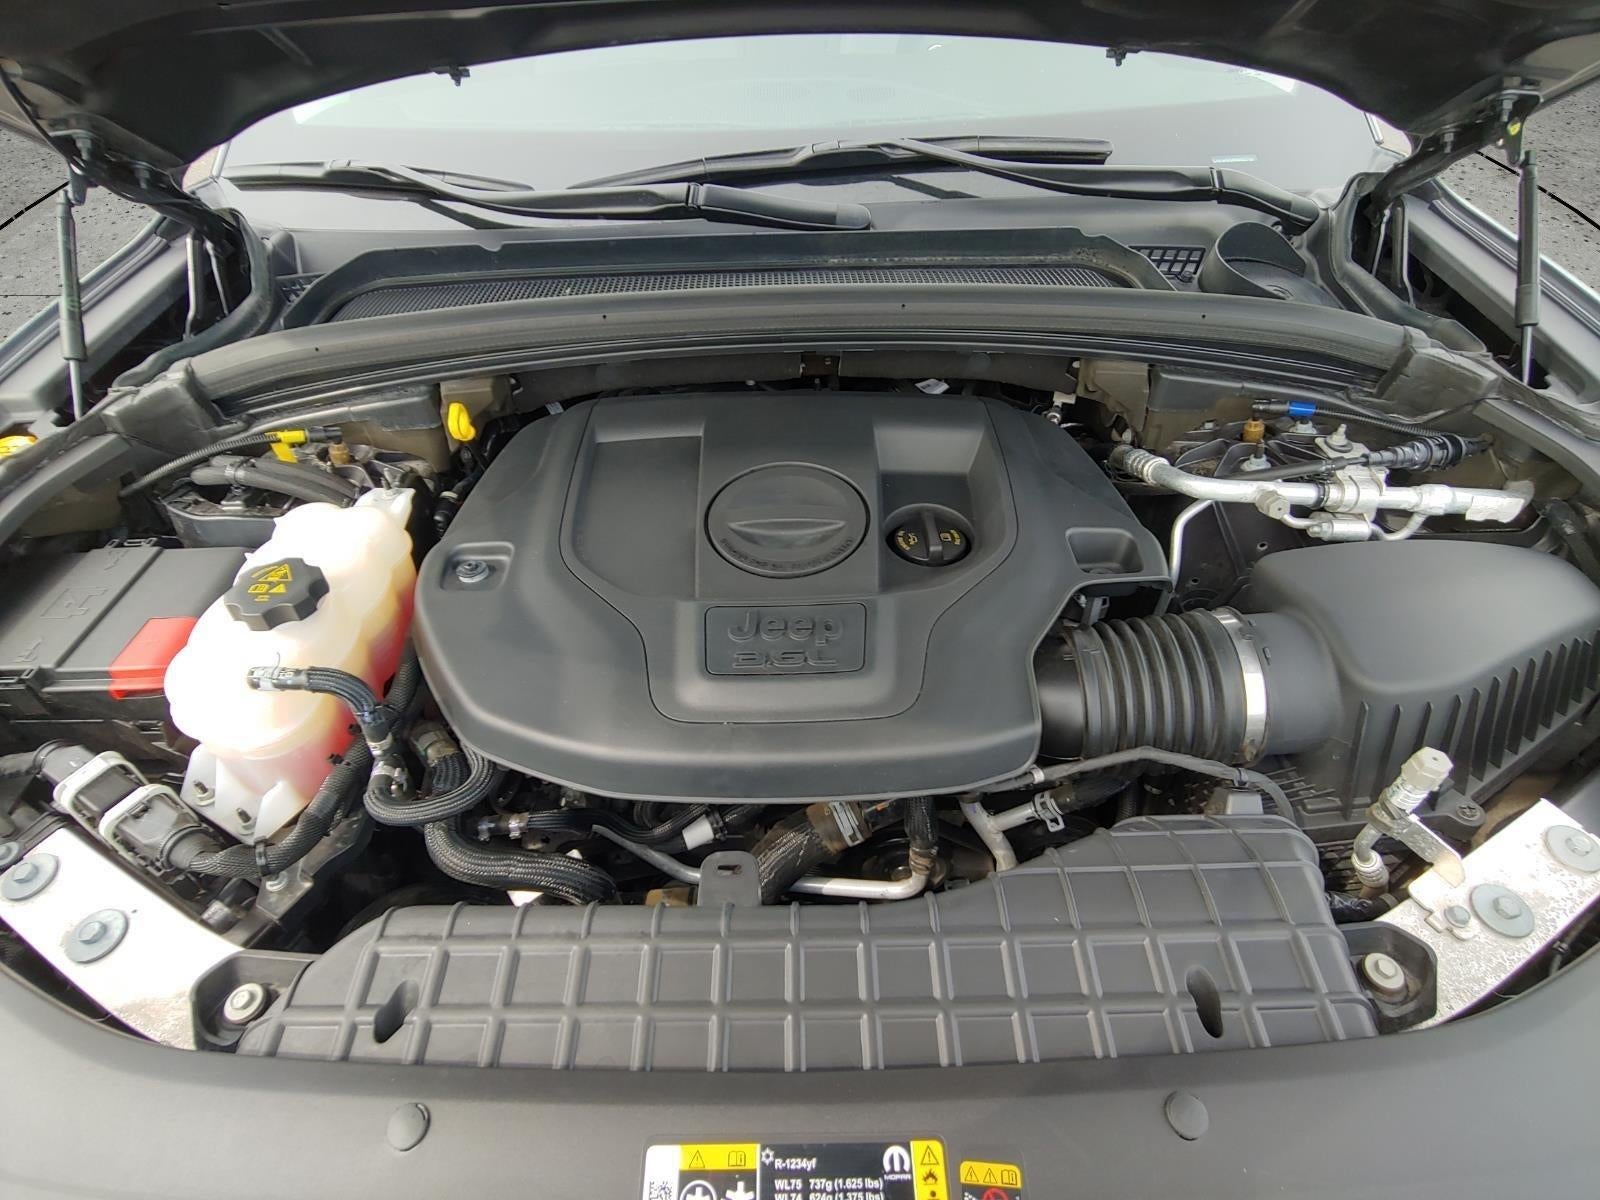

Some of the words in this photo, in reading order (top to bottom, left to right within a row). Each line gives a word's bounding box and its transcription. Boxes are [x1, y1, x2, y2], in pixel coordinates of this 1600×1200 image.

[727, 609, 842, 646] Jeep
[774, 1158, 816, 1171] R-1234yf
[774, 1179, 802, 1190] WL75
[809, 1178, 833, 1191] 737g
[834, 1178, 863, 1191] (1.625
[865, 1177, 884, 1191] lbs)
